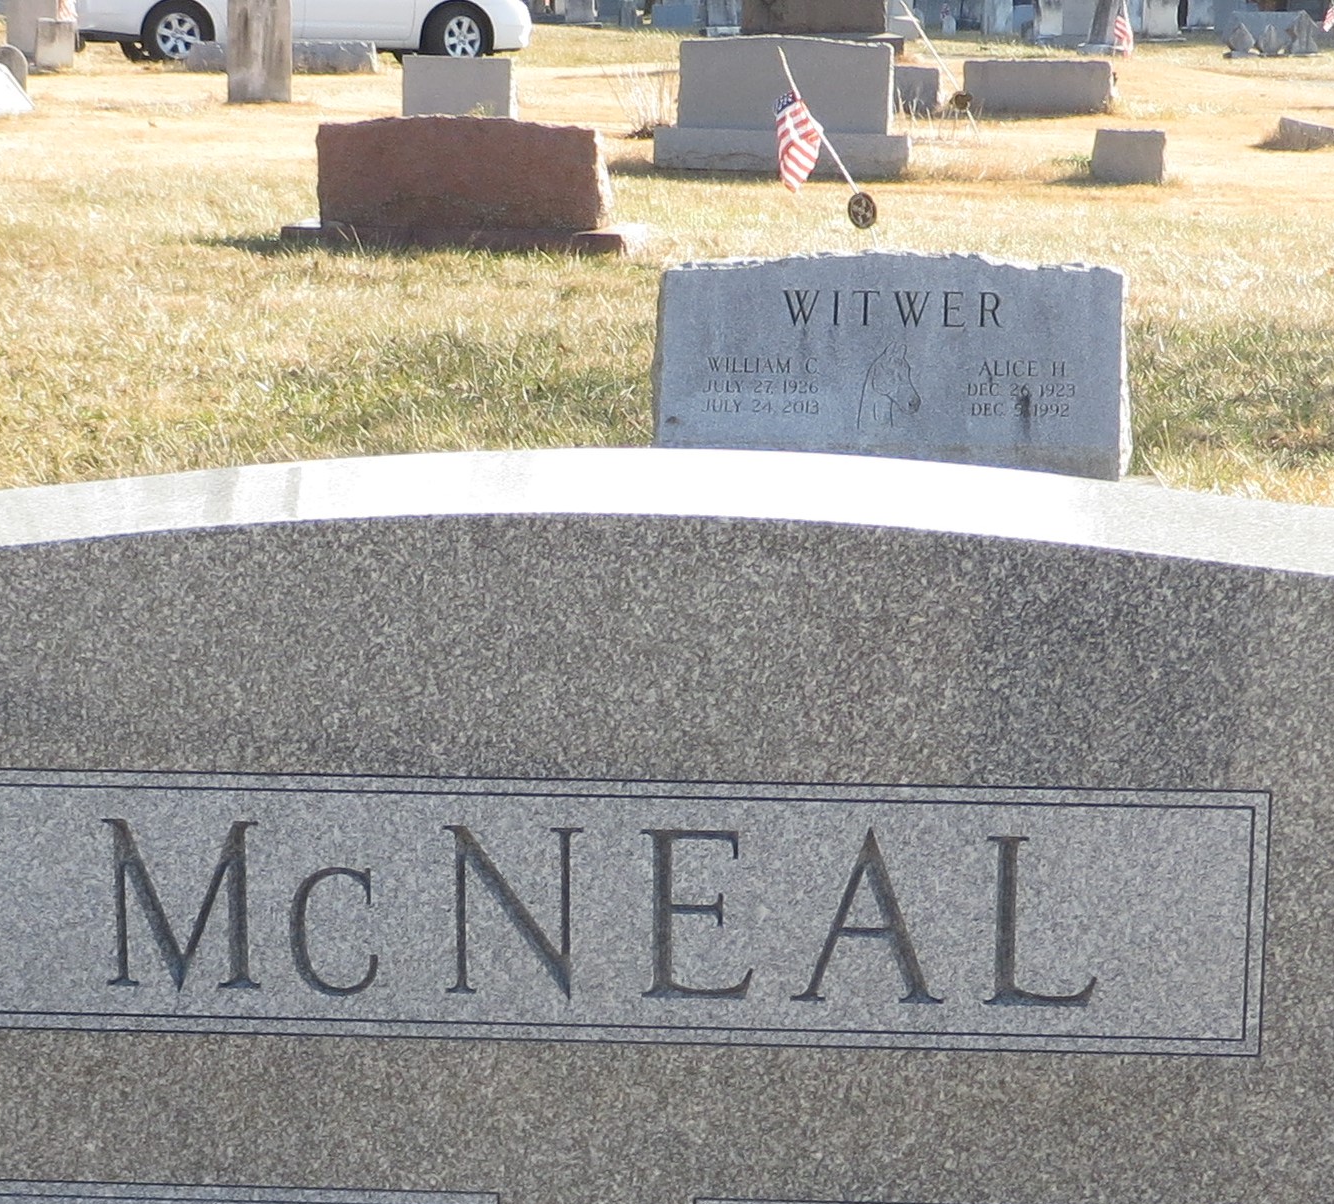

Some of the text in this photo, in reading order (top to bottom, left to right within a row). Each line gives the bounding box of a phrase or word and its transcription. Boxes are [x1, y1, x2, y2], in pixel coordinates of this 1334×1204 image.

[782, 288, 1004, 329] WITWER
[707, 357, 792, 374] WILLIAM
[978, 360, 1039, 379] ALICE
[703, 379, 819, 395] JULY 27, 1926
[1039, 383, 1076, 398] 1923
[701, 399, 742, 413] JULY
[782, 399, 820, 415] 2013
[1033, 403, 1070, 418] 1992
